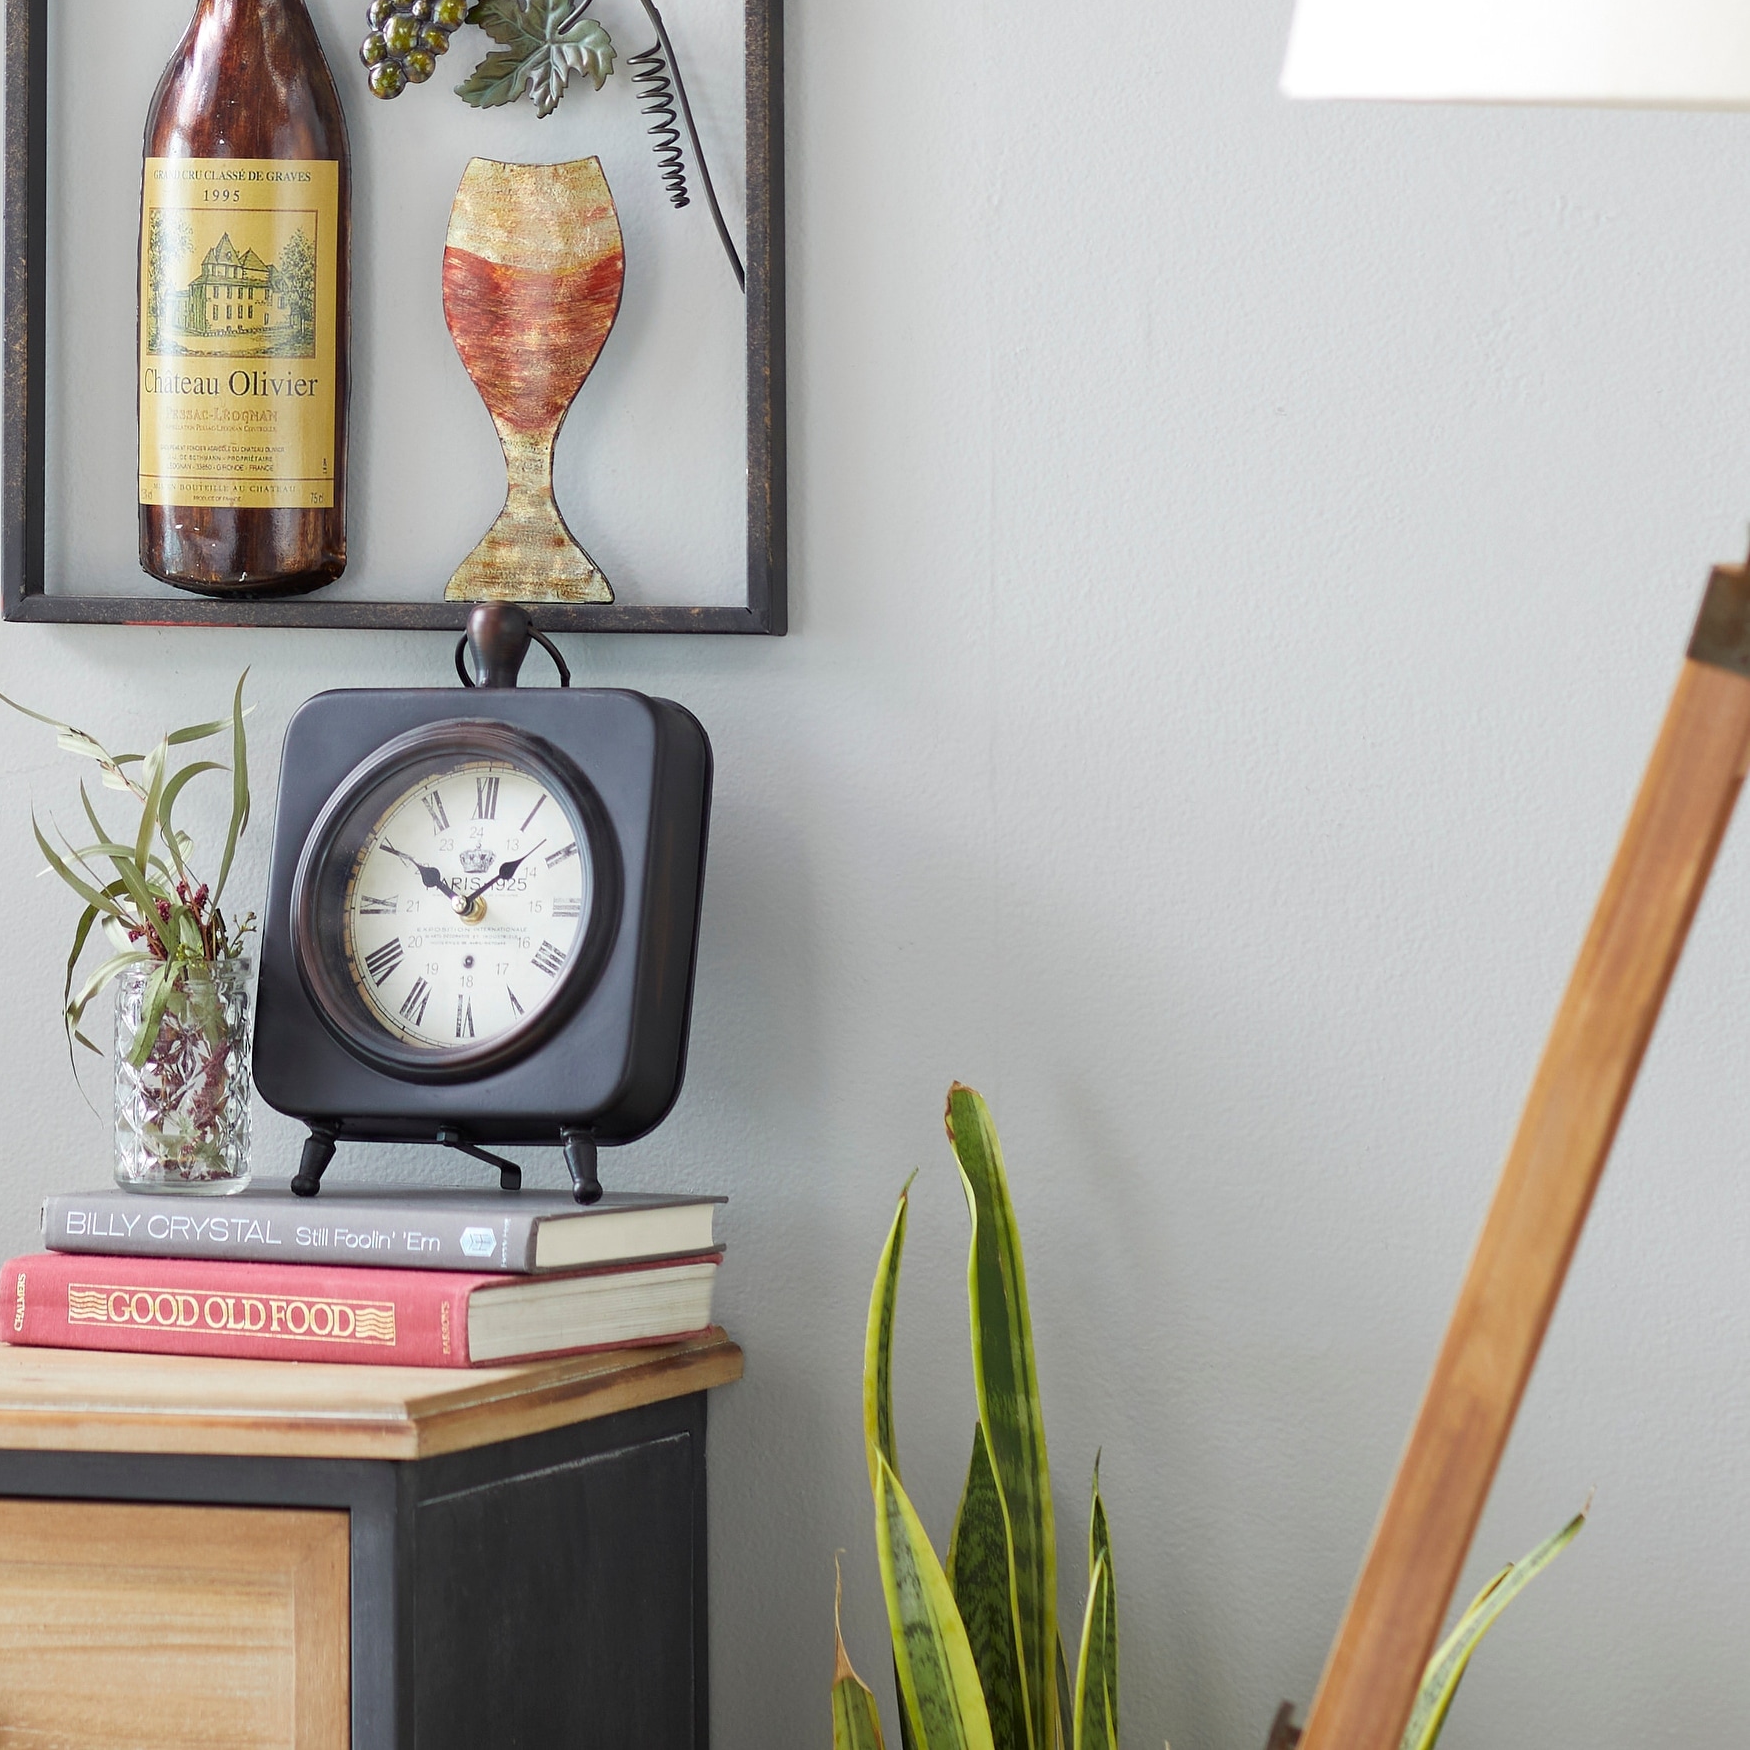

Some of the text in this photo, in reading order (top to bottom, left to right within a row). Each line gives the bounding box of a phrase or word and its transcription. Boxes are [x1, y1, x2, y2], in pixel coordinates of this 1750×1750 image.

[182, 170, 202, 181] CRU
[204, 168, 245, 181] CLASSÉ
[248, 171, 264, 181] DE
[266, 171, 311, 182] GRAVES
[203, 189, 240, 202] 1995
[144, 368, 318, 397] Château Olivier
[469, 826, 484, 838] 24
[439, 838, 454, 851] 23
[506, 838, 519, 851] 13
[524, 867, 537, 879] 14
[426, 877, 481, 891] ARIS
[406, 901, 420, 913] 21
[529, 901, 542, 913] 15
[408, 935, 423, 948] 20
[517, 936, 531, 949] 16
[425, 963, 439, 975] 19
[496, 963, 509, 975] 17
[460, 975, 474, 988] 18
[66, 1211, 440, 1251] BILLY CRYSTAL Still Foolin' 'Em
[14, 1272, 27, 1332] CHALMERS
[107, 1291, 356, 1337] GOOD OLD FOOD
